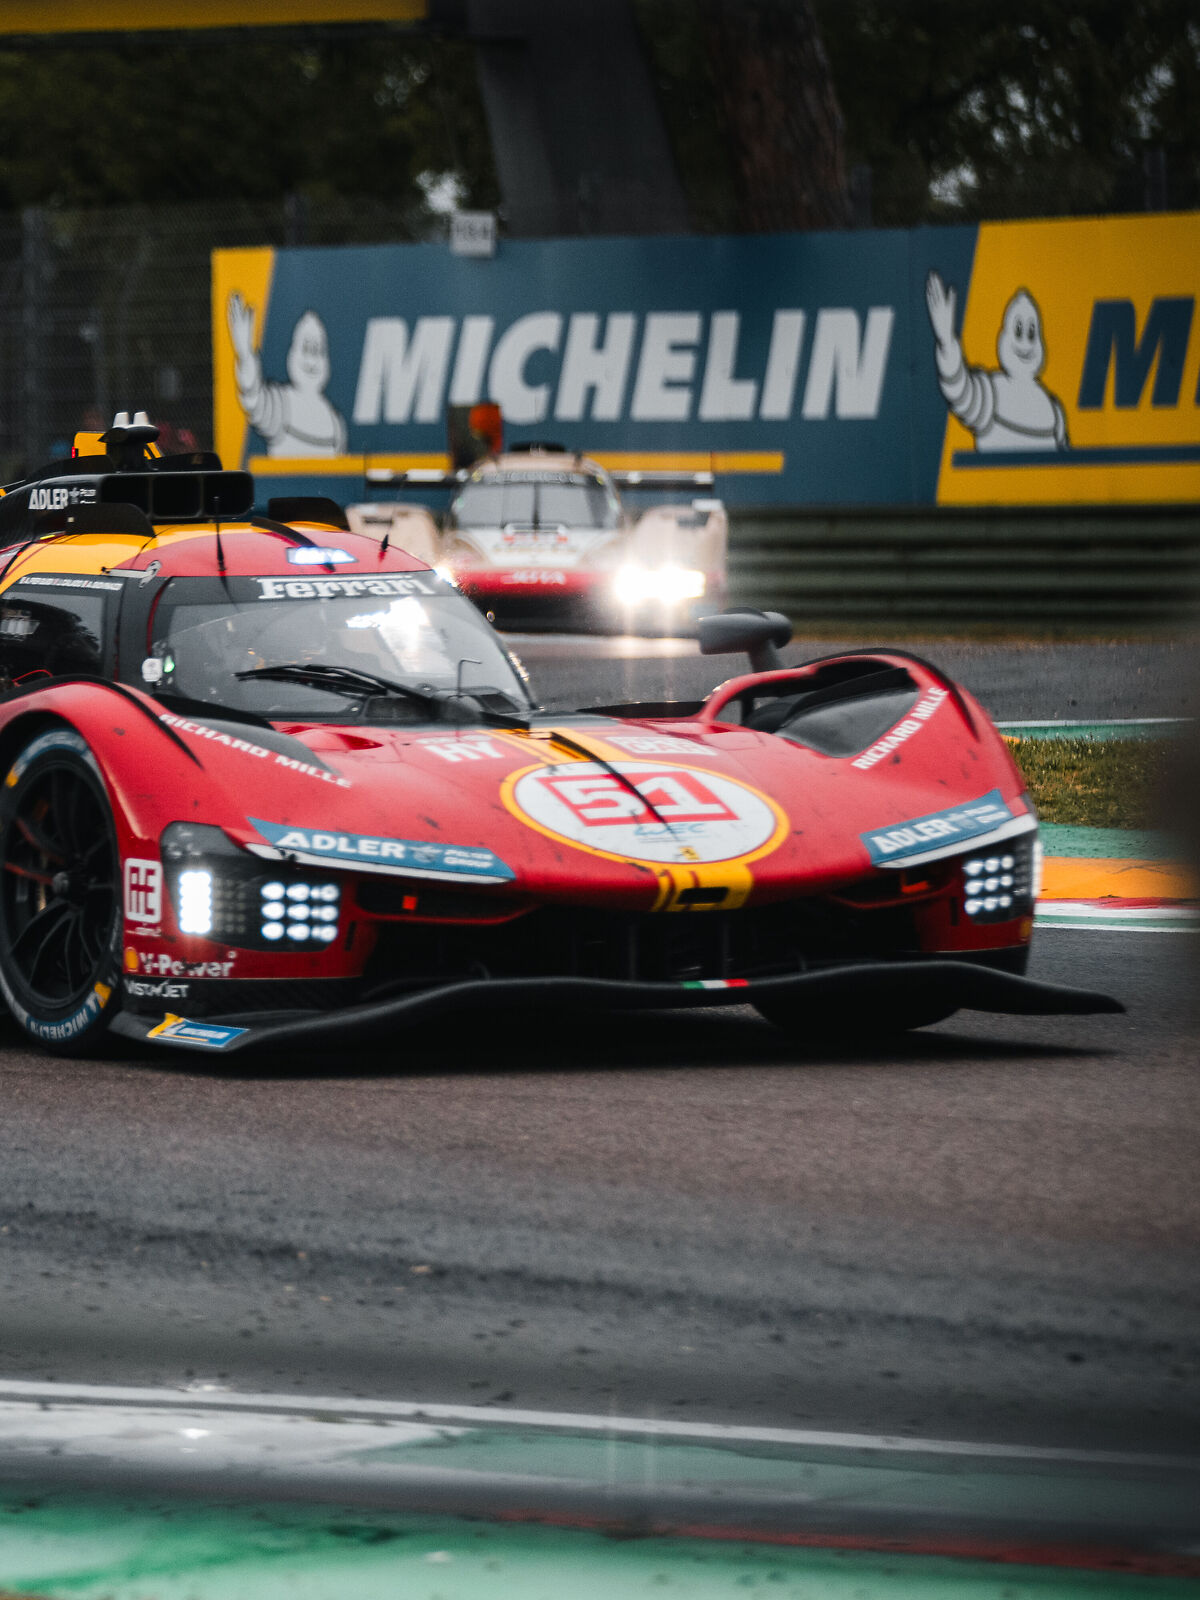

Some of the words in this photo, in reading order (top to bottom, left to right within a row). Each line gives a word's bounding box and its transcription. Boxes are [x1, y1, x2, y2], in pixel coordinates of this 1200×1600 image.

[352, 305, 895, 425] MICHELIN
[1076, 293, 1200, 412] M
[28, 488, 69, 510] ADLER
[251, 574, 436, 600] Ferrari
[851, 719, 924, 770] RICHARD
[910, 687, 949, 721] MILLE
[158, 713, 270, 759] RICHARD
[274, 754, 351, 788] MILLE
[549, 776, 728, 820] 51
[275, 832, 406, 859] ADLER
[871, 818, 961, 854] ADLER
[30, 1008, 89, 1040] MICHELIN
